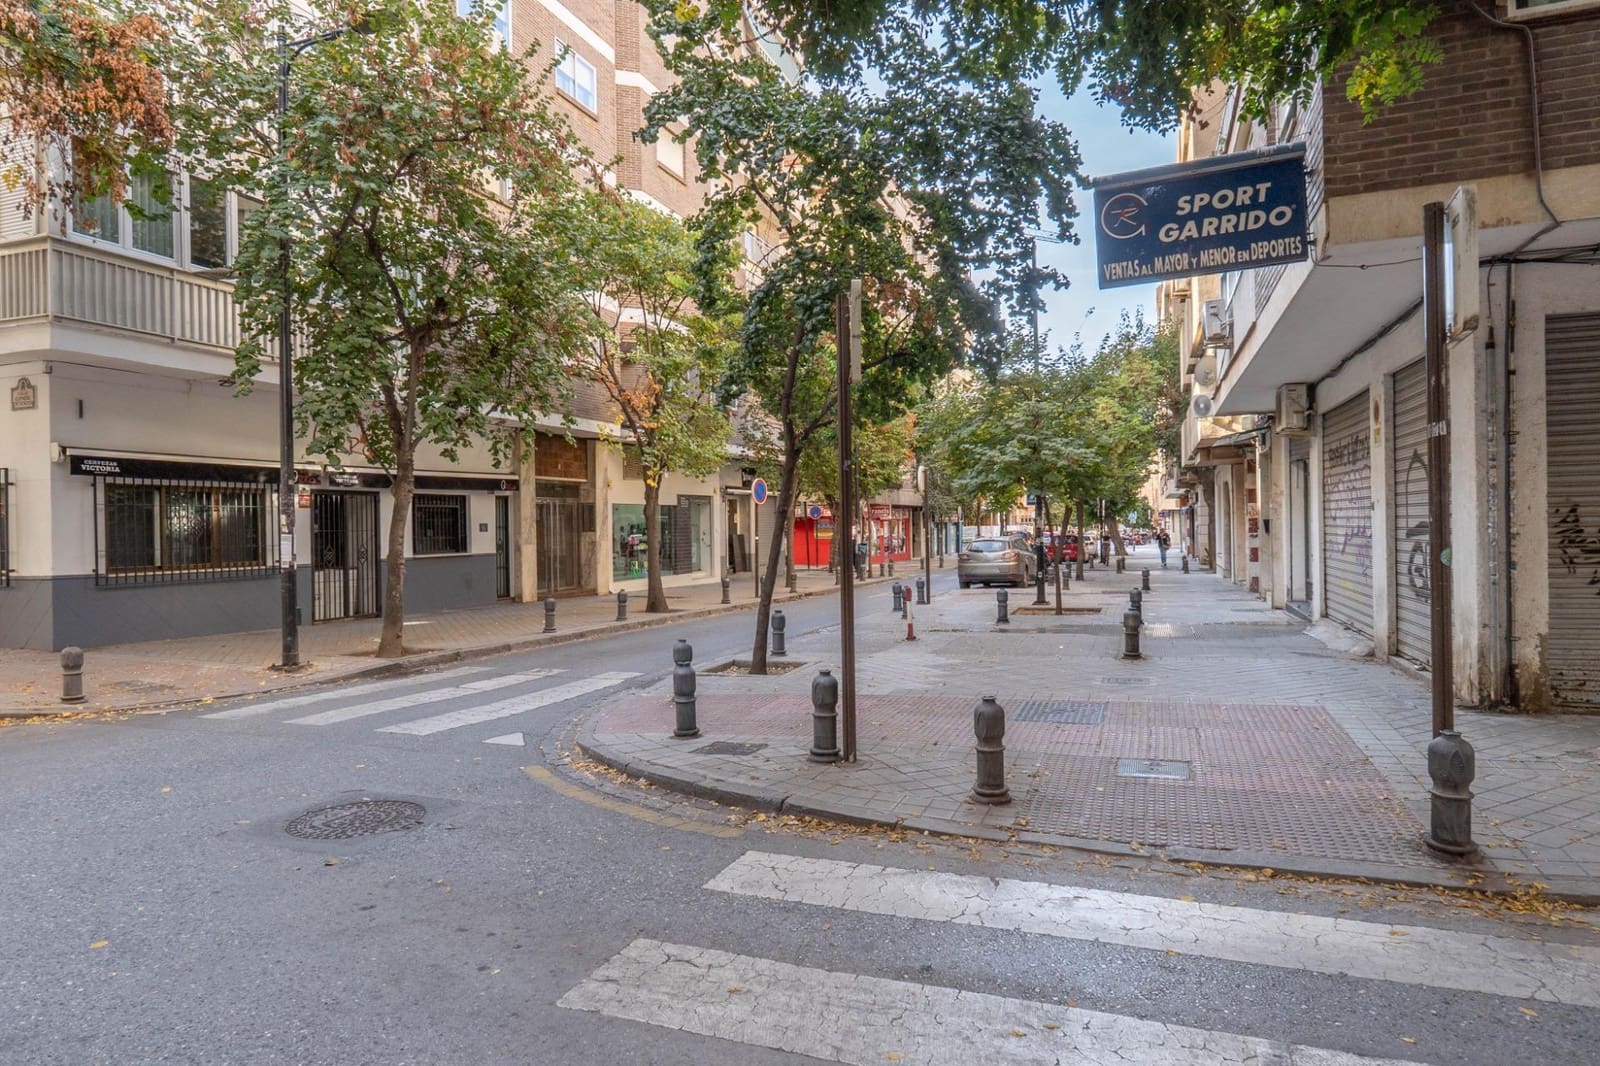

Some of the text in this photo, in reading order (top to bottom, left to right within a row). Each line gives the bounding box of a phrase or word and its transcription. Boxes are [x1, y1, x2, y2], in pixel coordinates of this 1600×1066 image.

[1176, 182, 1272, 215] SPORT
[1158, 205, 1293, 243] GARRIDO
[1104, 235, 1302, 280] VENTAS AL MAYOR Y MENOR EN DEPORTES
[80, 464, 120, 472] VICTORIA
